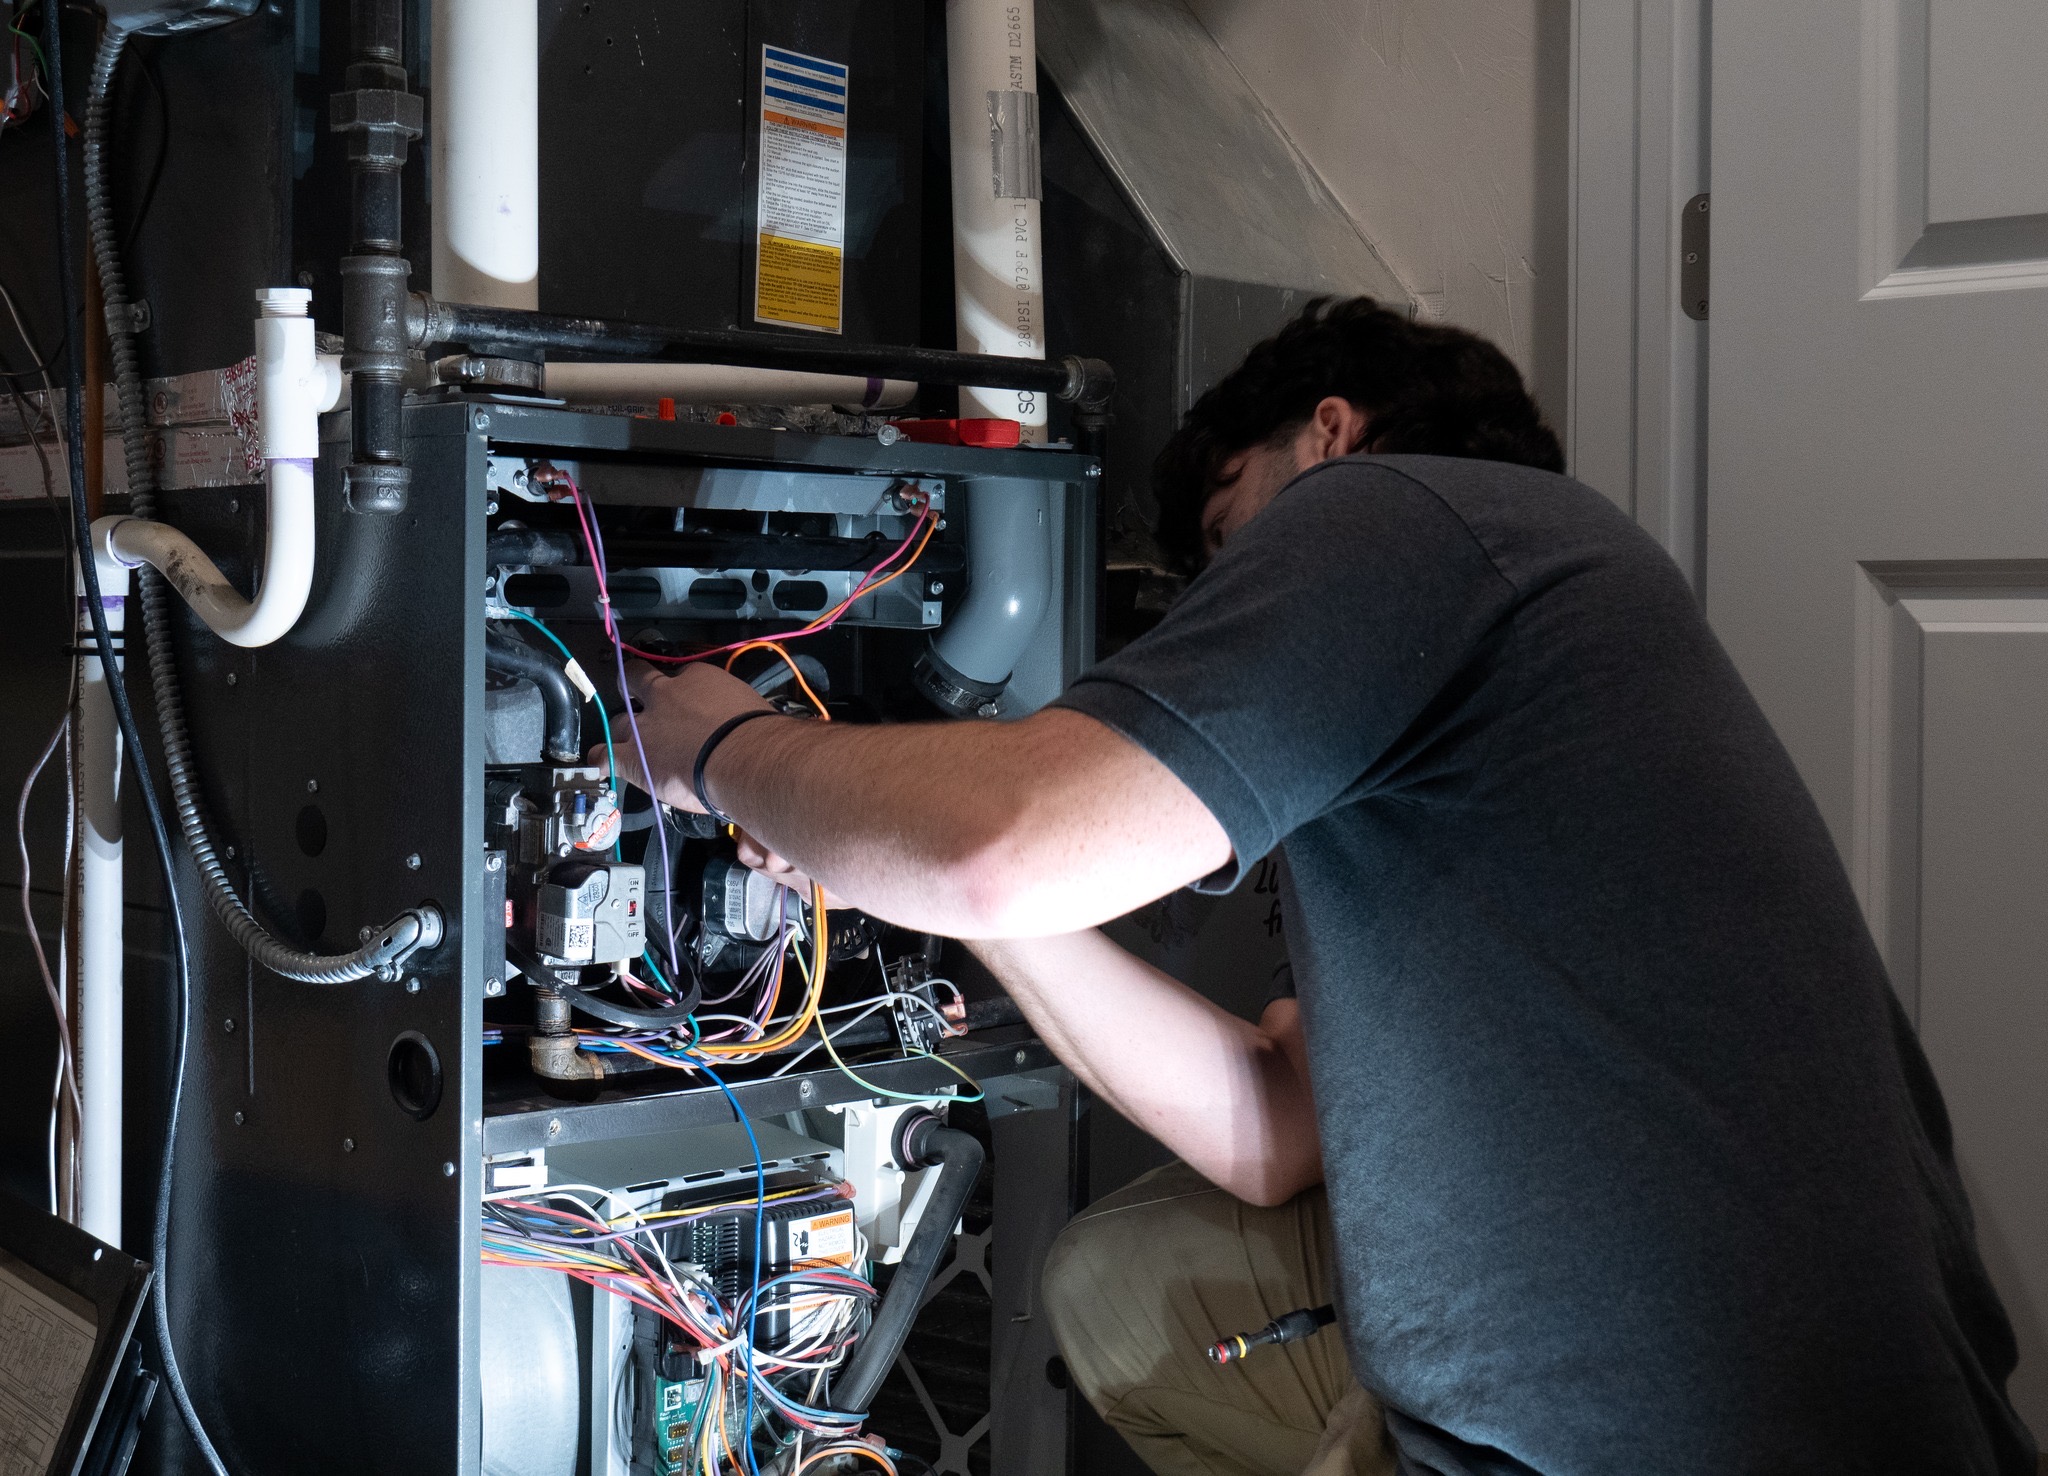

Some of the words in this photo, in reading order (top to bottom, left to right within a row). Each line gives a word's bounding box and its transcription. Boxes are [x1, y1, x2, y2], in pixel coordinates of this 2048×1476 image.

[1008, 5, 1021, 49] D2665
[1011, 52, 1024, 89] ASTM
[1015, 212, 1028, 243] PVC
[1017, 299, 1032, 348] 280PSI
[819, 1215, 850, 1228] WARNING
